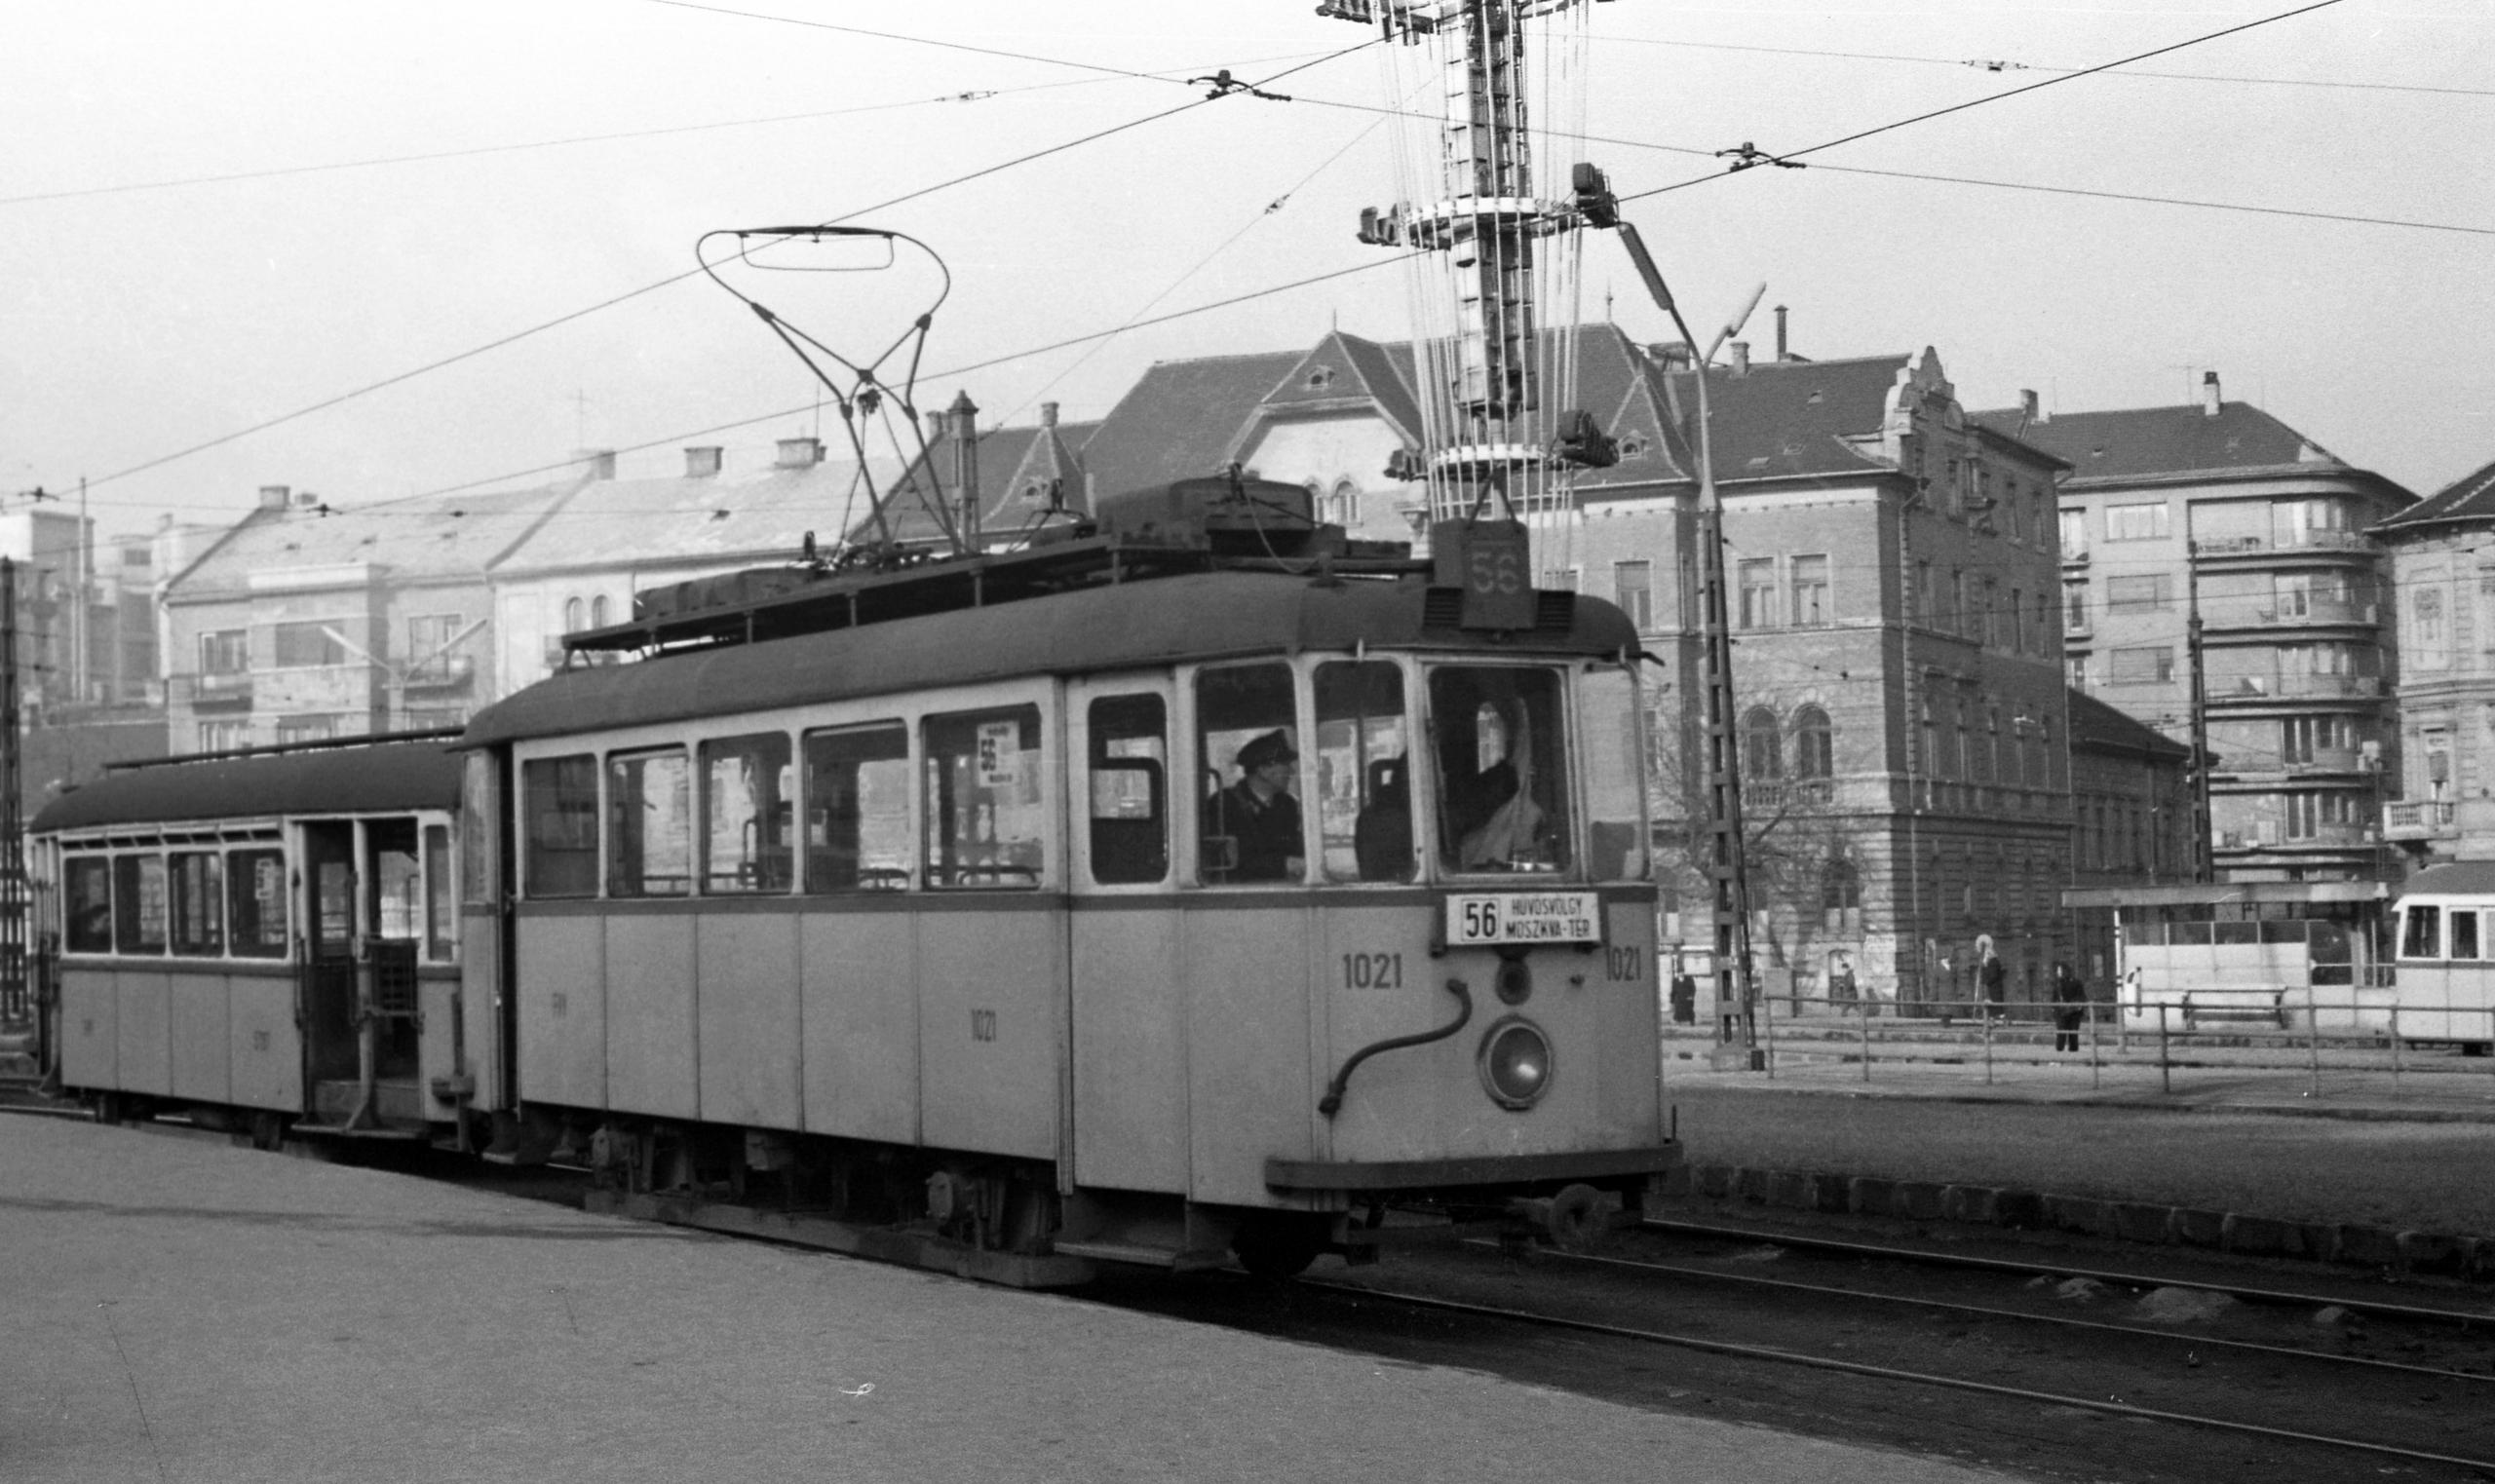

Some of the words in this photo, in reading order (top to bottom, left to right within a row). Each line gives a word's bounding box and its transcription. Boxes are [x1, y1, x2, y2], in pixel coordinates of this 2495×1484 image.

[1472, 552, 1518, 593] 56
[1465, 901, 1497, 938] 56
[1343, 953, 1401, 989] 1021
[972, 1009, 996, 1042] 1021
